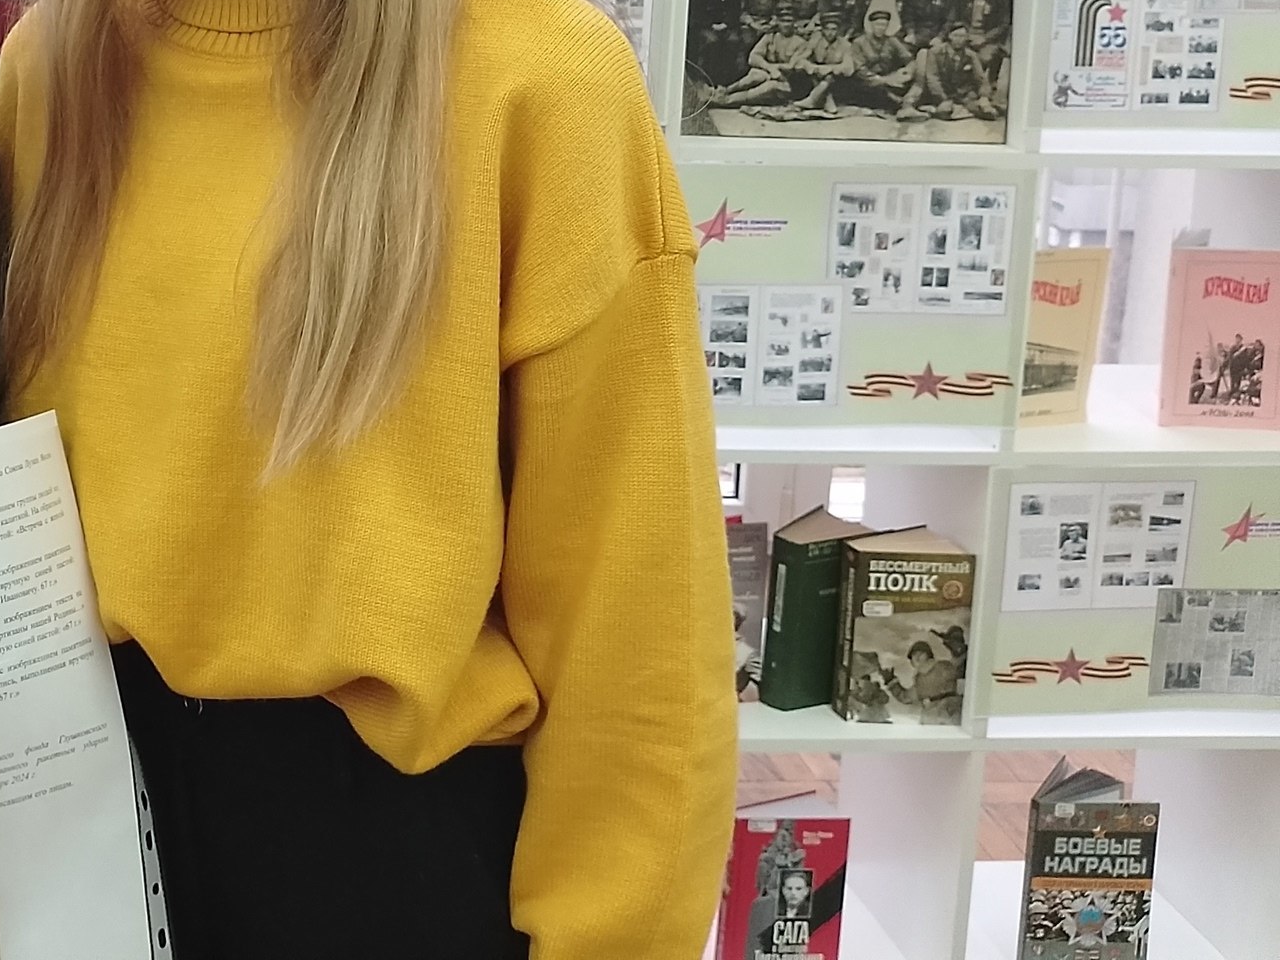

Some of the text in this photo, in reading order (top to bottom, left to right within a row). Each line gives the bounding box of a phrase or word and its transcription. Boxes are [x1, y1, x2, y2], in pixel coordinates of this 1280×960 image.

[869, 559, 970, 573] БЕССМЕРТНЫЙ
[867, 573, 939, 592] ПОЛК
[1054, 837, 1142, 855] БОЕВЫЕ
[1044, 856, 1148, 877] НАГРАДЫ
[773, 920, 810, 944] САГА
